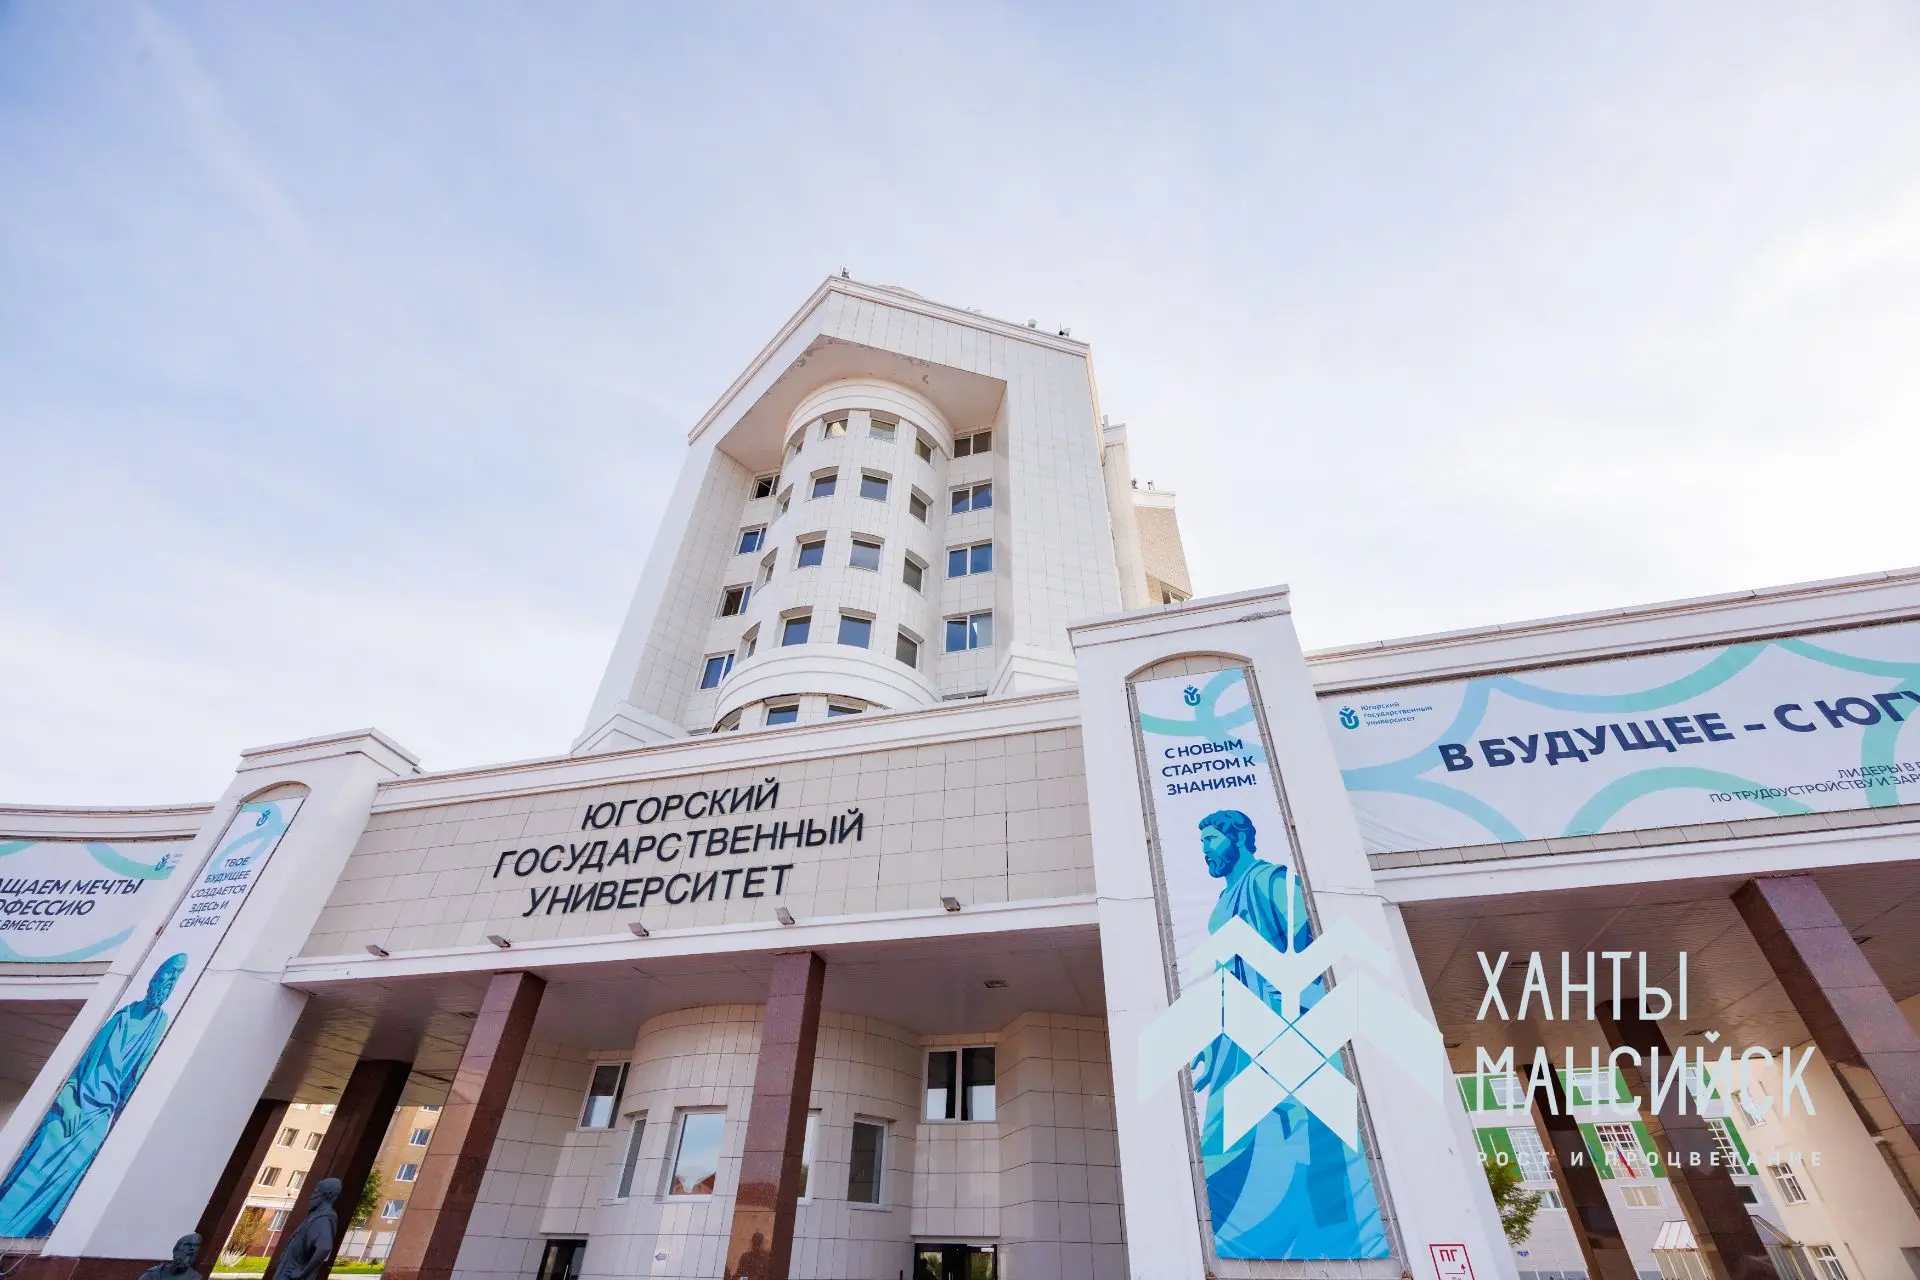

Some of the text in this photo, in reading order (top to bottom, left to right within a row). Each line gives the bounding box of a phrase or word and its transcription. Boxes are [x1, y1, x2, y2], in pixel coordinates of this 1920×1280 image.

[1360, 702, 1400, 711] Югорский
[1363, 706, 1433, 718] государственный
[1366, 716, 1415, 727] университет
[1438, 743, 1474, 772] В
[1478, 712, 1736, 767] БУДУЩЕЕ
[1773, 703, 1817, 733] С
[1164, 739, 1243, 759] С НОВЫМ
[1162, 755, 1256, 777] СТАРТОМ К
[1838, 764, 1903, 779] ЛИДЕРЫ
[1902, 762, 1915, 771] В
[1166, 773, 1257, 796] ЗНАНИЯМ!
[1709, 773, 1920, 803] ПО ТРУДОУСТРОЙСТВУ И ЗАР
[581, 777, 780, 831] ЮГОРСКИЙ
[493, 808, 864, 879] ГОСУДАРСТВЕННЫЙ
[224, 856, 252, 868] ТВОЕ
[204, 870, 252, 884] БУДУЩЕЕ
[69, 878, 145, 895] МЕЧТЫ
[190, 884, 247, 899] СОЗДАЕТСЯ
[522, 864, 794, 917] УНИВЕРСИТЕТ
[188, 900, 229, 914] ЗДЕСЬ И
[179, 915, 220, 928] СЕЙЧАС!
[1439, 1249, 1457, 1262] ПГ
